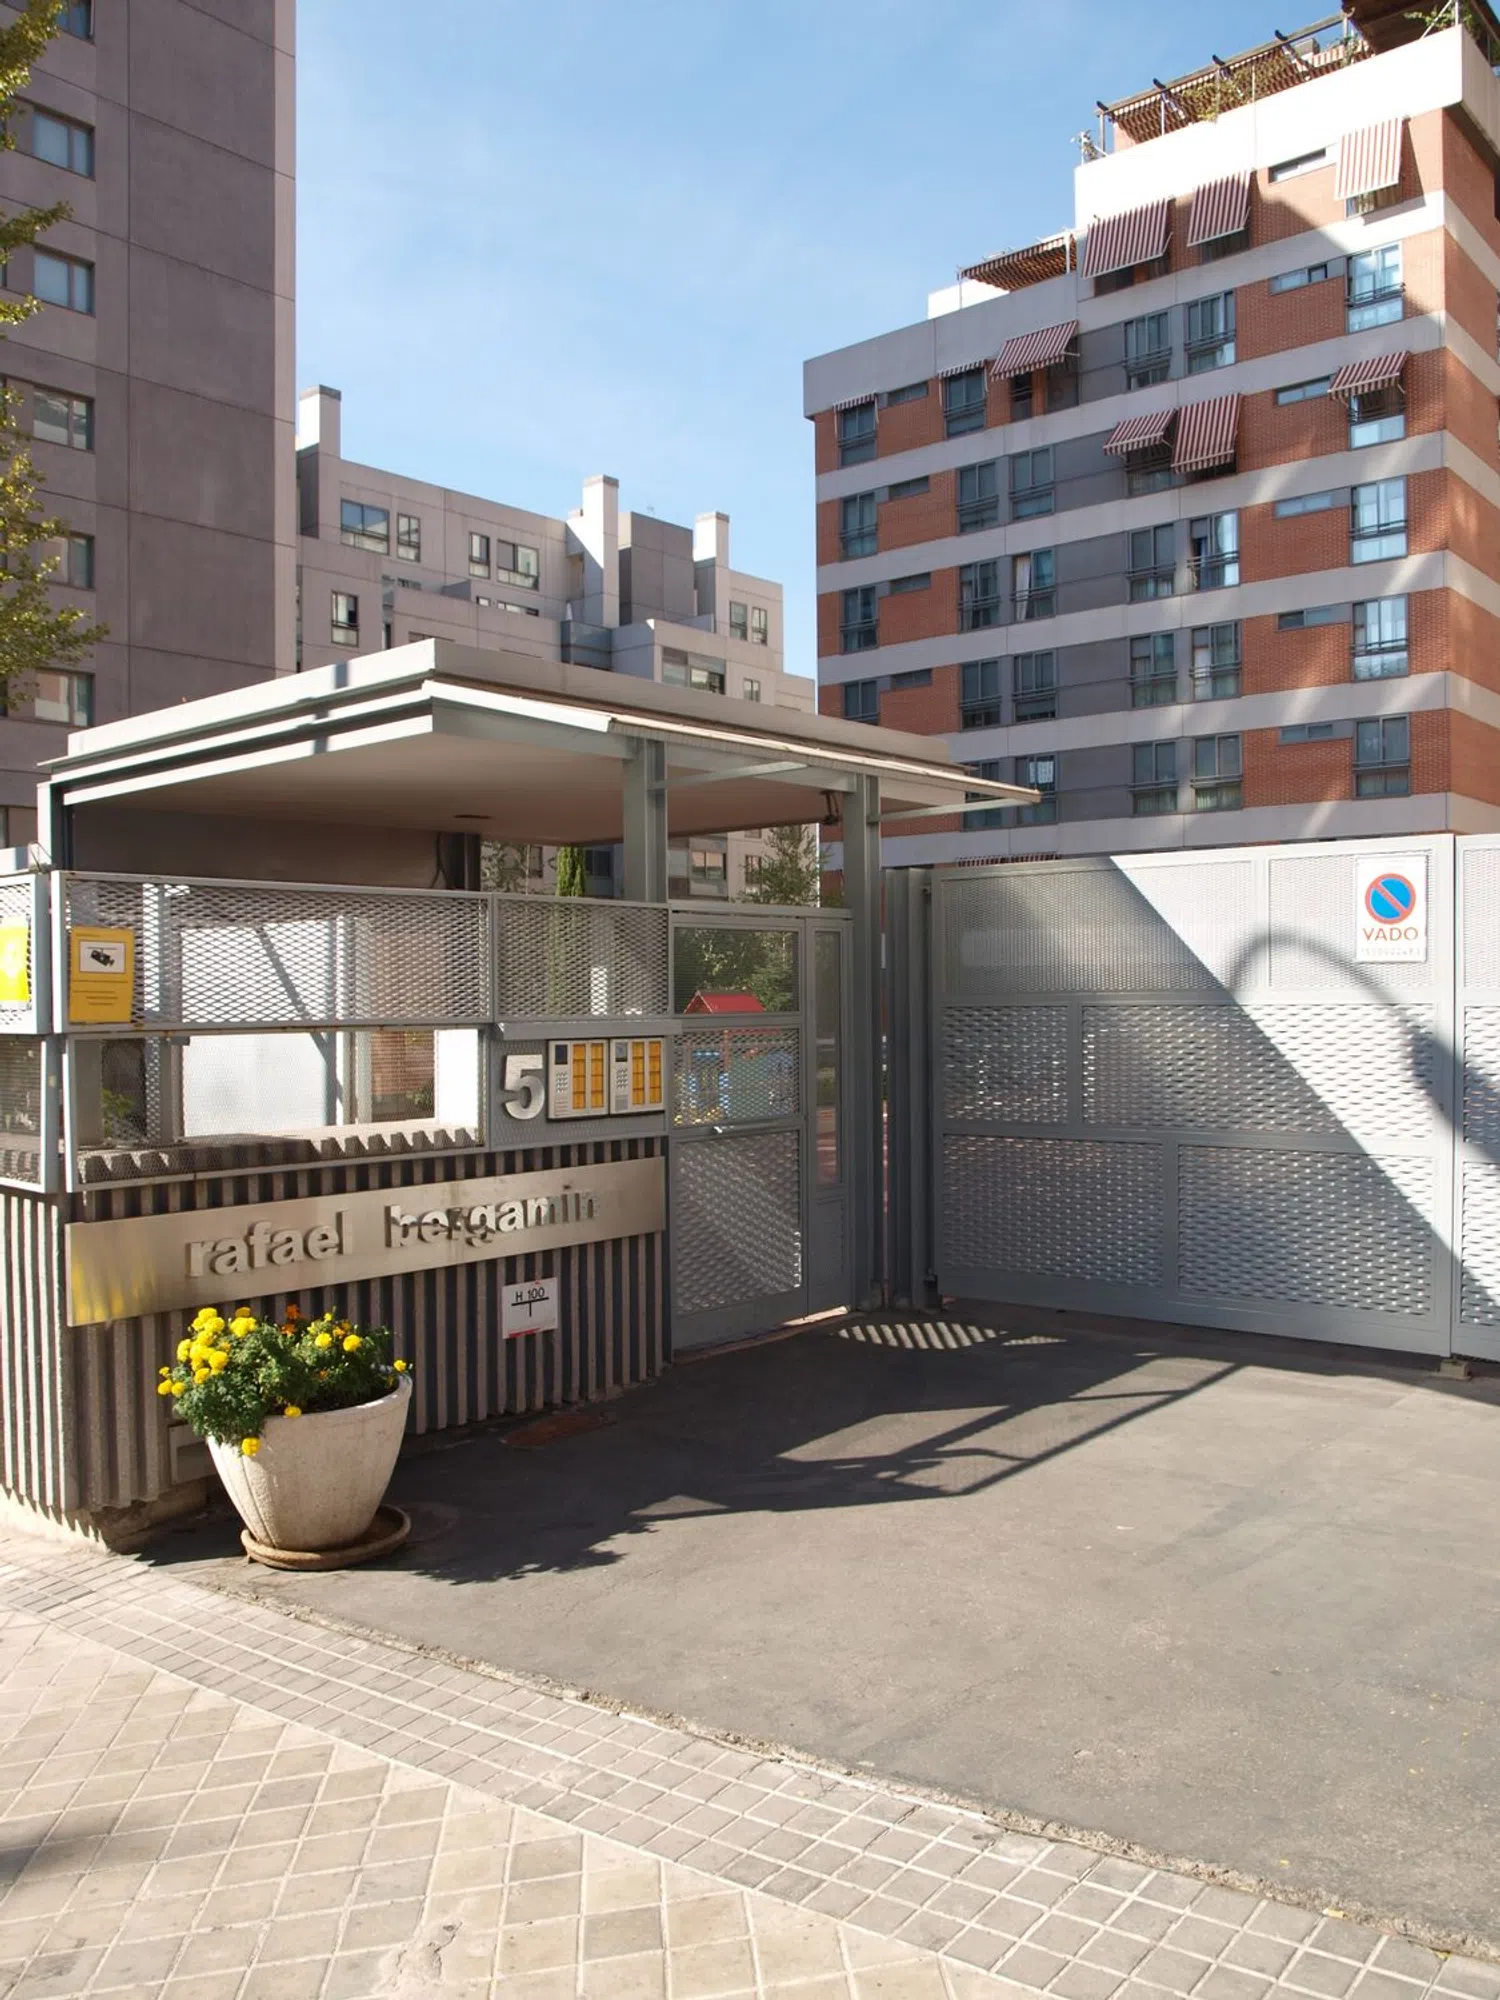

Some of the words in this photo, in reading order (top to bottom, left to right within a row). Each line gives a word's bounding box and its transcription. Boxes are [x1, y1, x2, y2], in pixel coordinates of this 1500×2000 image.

[1362, 926, 1419, 941] VADO
[504, 1054, 545, 1120] 5
[185, 1210, 353, 1278] rafael
[385, 1191, 600, 1248] bergamin
[515, 1291, 524, 1303] H
[527, 1286, 545, 1301] 100
